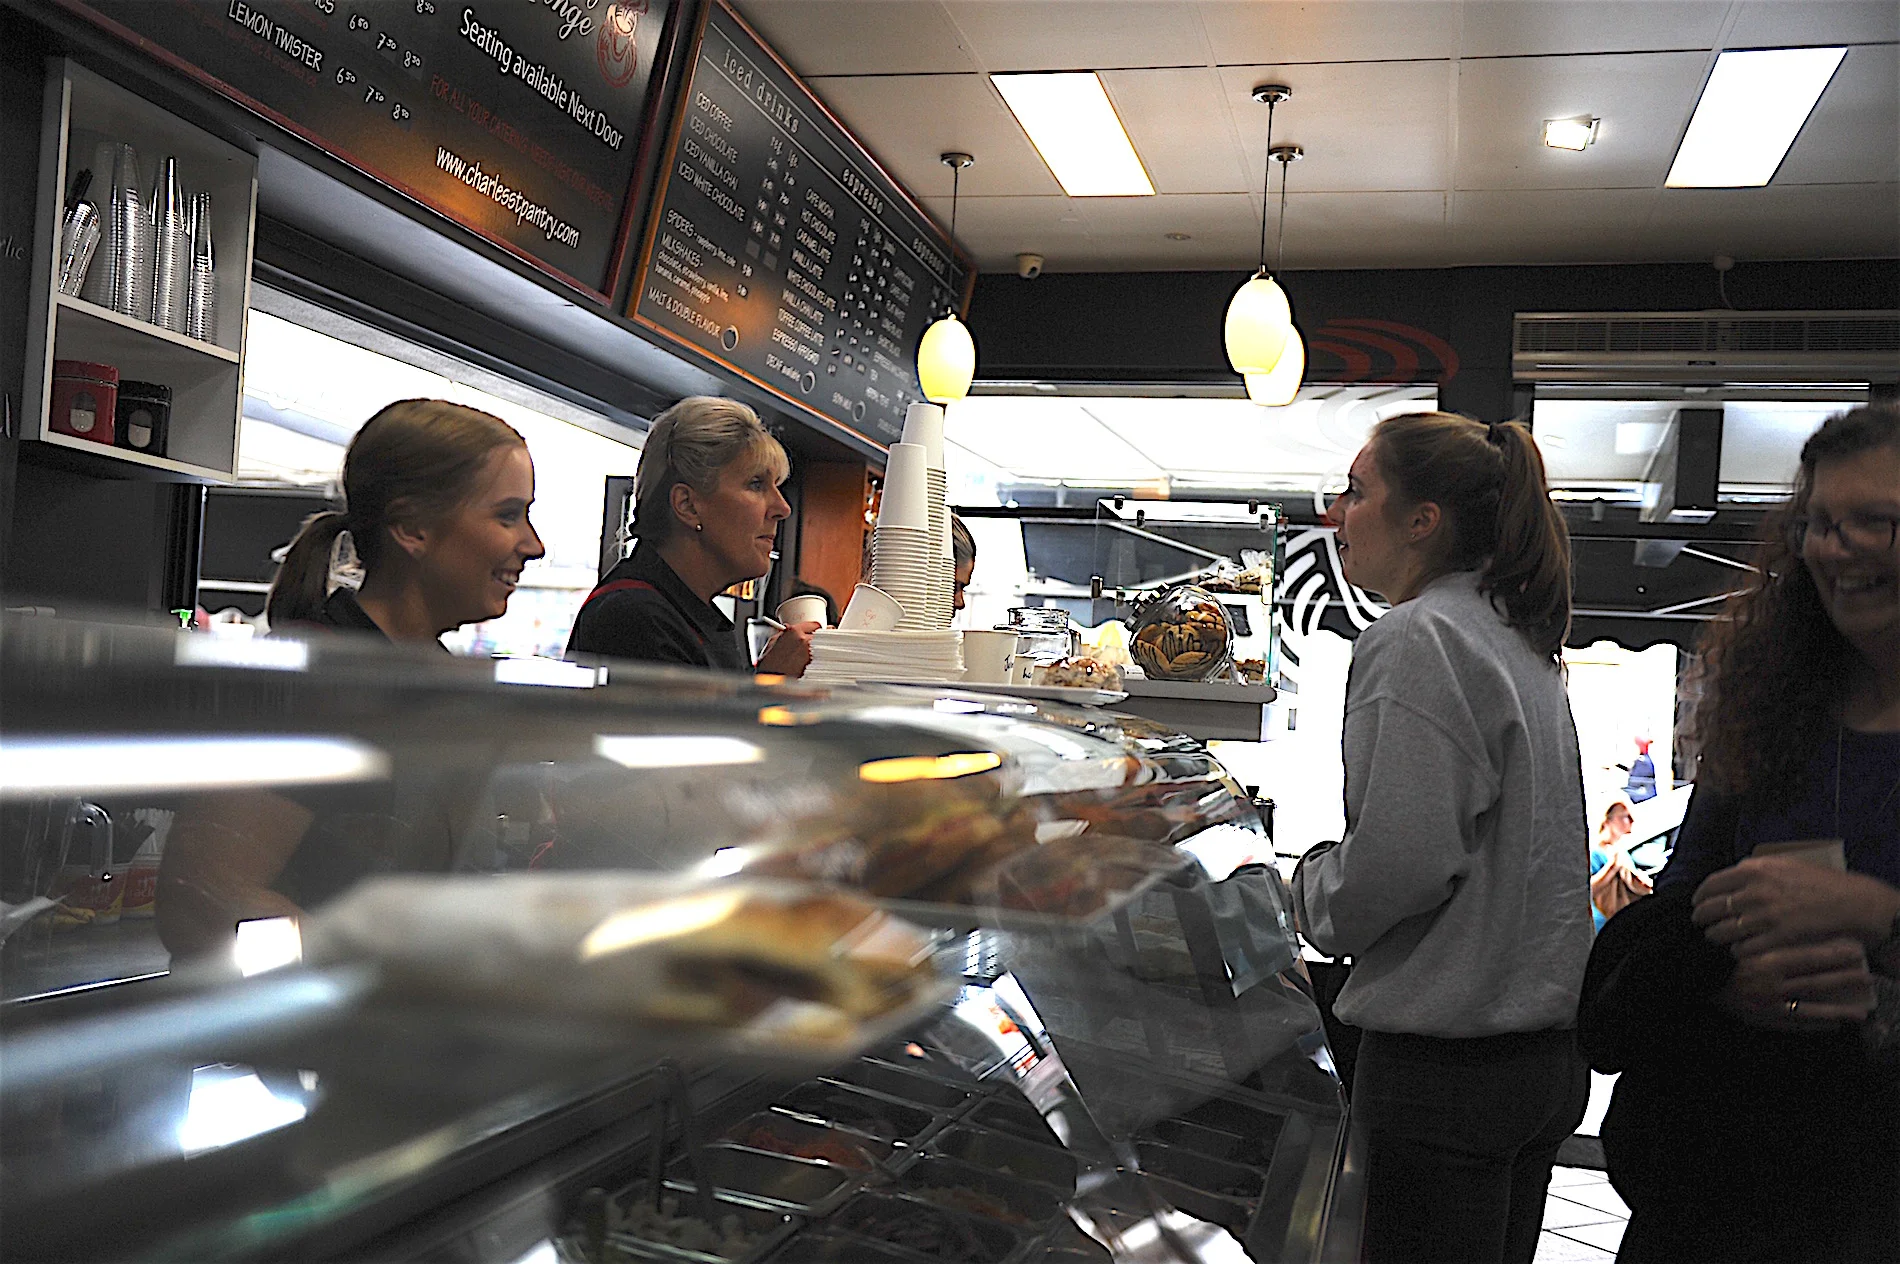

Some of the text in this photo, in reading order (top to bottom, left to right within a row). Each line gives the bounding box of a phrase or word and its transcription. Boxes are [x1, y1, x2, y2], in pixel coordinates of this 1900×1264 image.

[229, 0, 273, 40] LEMON
[275, 26, 322, 72] TWISTER
[460, 8, 623, 150] Seating available Next Door
[723, 49, 799, 133] iced drinks
[450, 87, 466, 111] ALL
[468, 100, 489, 126] YOUR
[695, 90, 733, 132] ICED COFFEE
[683, 136, 701, 158] ICED
[698, 149, 724, 179] VANILLA
[723, 170, 739, 191] CHAI
[689, 114, 738, 164] ICED CHOCOLATE
[436, 146, 581, 249] www.charlesstpantry.com
[678, 160, 695, 182] ICED
[692, 172, 714, 197] WHITE
[711, 187, 746, 222] CHOCOLATE
[843, 168, 883, 215] espresso
[666, 209, 694, 237] SPIDERS
[810, 216, 837, 245] CHOCOLATE
[661, 232, 701, 268] MILKSHAKES
[648, 286, 721, 338] MALT & DOUBLE FLAVOUR
